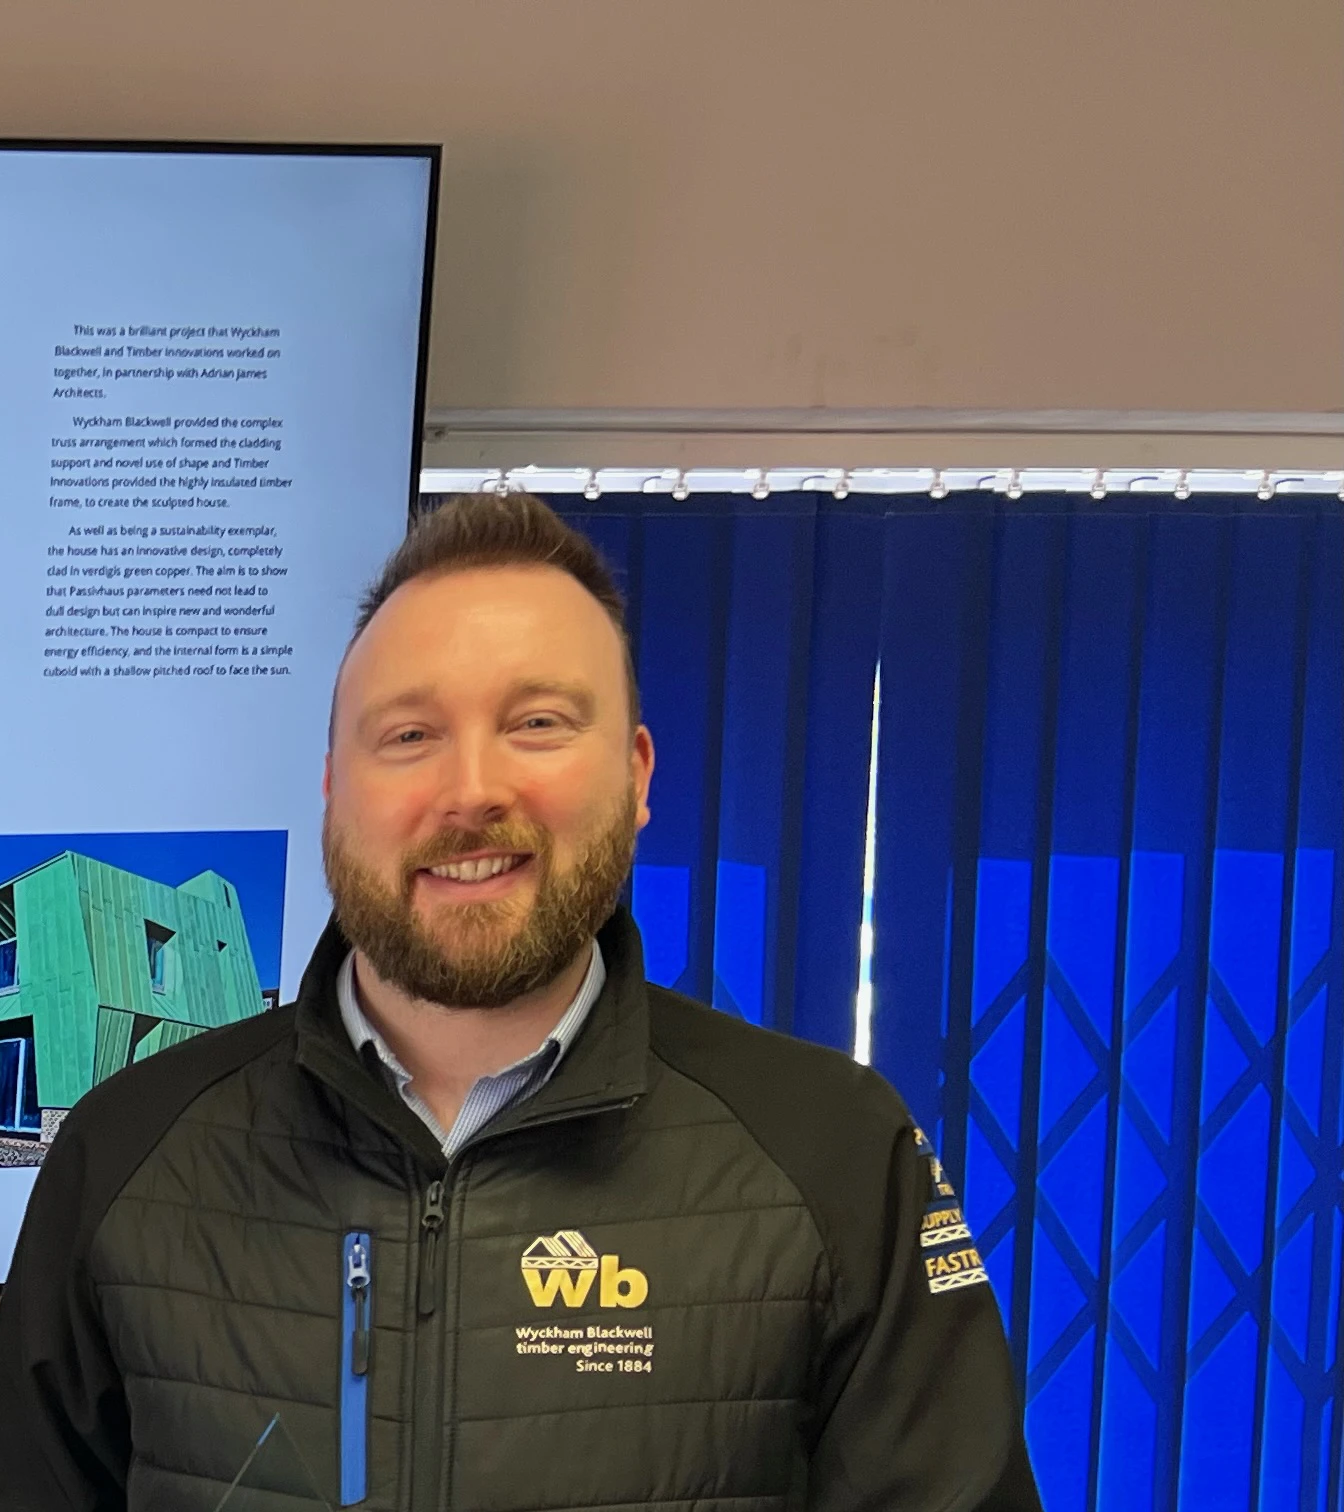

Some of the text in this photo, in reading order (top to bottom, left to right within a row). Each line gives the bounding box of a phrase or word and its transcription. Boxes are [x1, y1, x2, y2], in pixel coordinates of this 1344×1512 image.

[74, 325, 280, 340] This was a brilliant project that Wyckham
[521, 1254, 649, 1309] wb
[515, 1324, 653, 1342] Wyckham Blackwell
[515, 1341, 654, 1358] timber engineering
[575, 1359, 653, 1374] Since 1884
